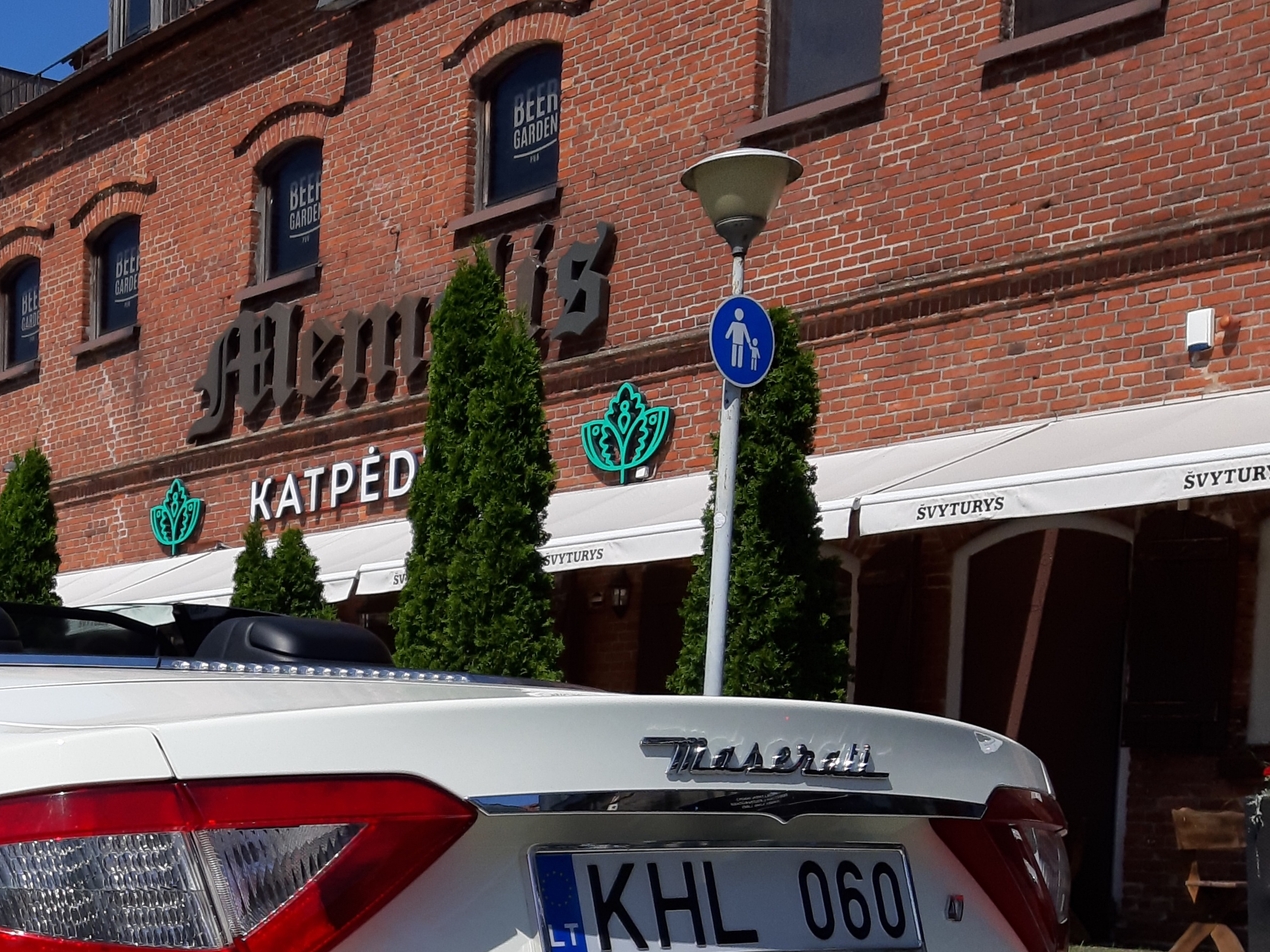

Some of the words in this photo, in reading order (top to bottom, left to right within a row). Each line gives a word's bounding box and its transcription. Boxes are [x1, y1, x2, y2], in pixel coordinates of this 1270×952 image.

[514, 78, 558, 128] BEER
[513, 112, 558, 149] GARDEN
[250, 446, 428, 522] KATPĖD
[916, 496, 1005, 521] ŠVYTURYS
[542, 548, 604, 567] ŠVYTURYS
[639, 736, 890, 778] Maserati
[587, 861, 760, 952] KHL
[798, 860, 907, 941] 060
[548, 921, 579, 948] LT
